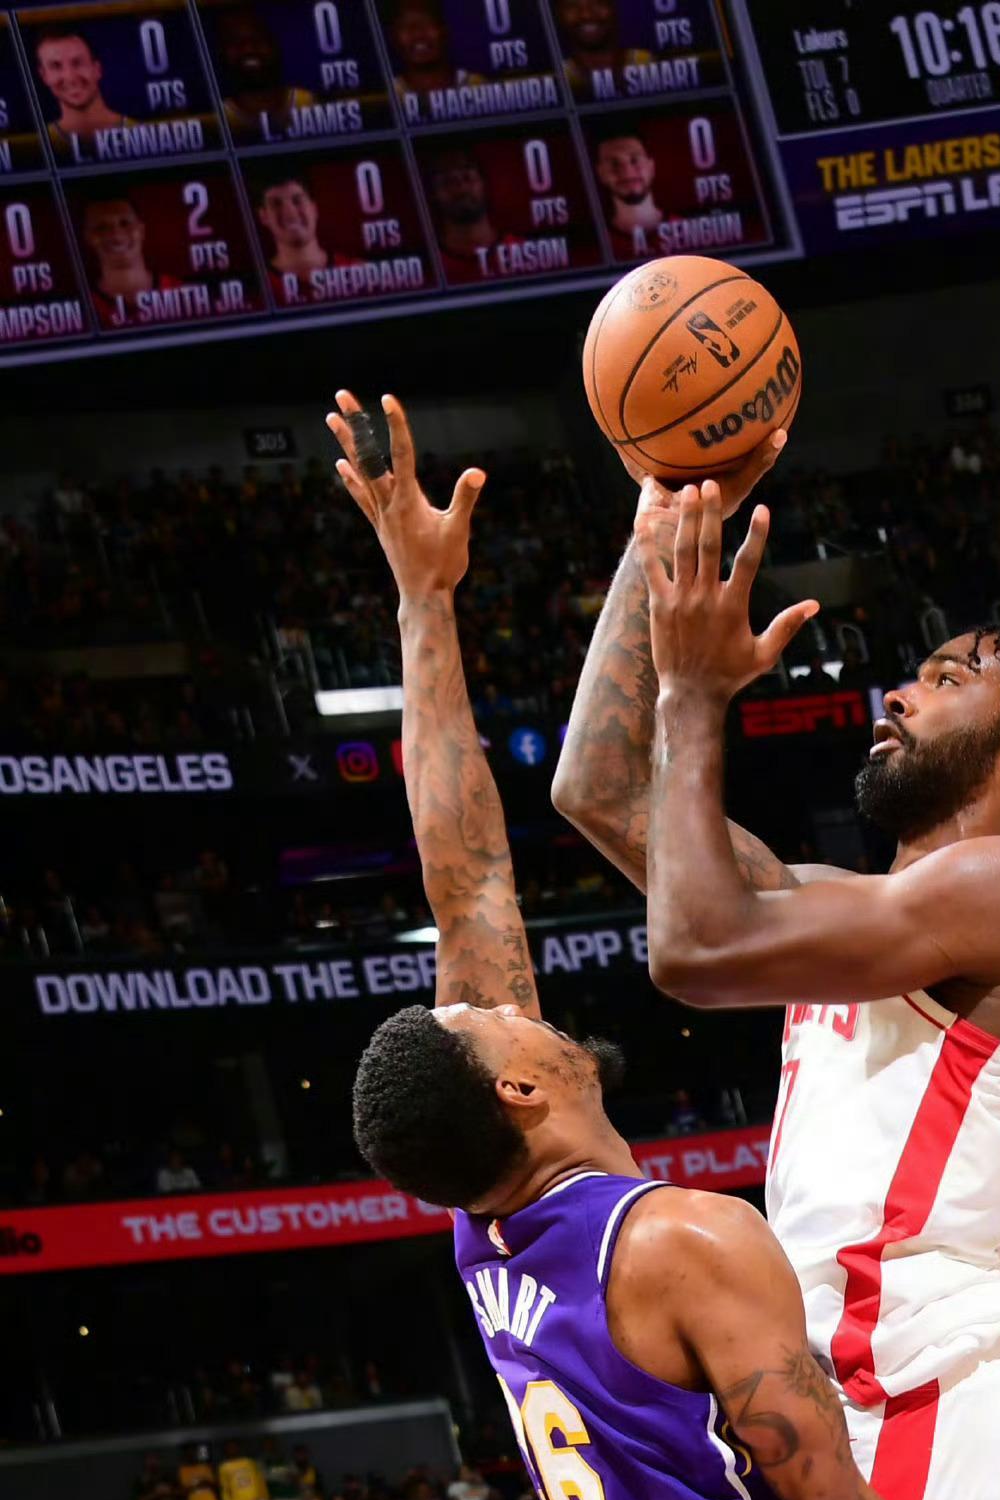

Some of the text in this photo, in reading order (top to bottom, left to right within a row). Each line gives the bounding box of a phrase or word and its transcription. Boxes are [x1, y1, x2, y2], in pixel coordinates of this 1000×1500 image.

[140, 20, 169, 74] 0
[314, 1, 342, 54] 0
[655, 18, 693, 47] PTS
[321, 60, 359, 89] PTS
[489, 40, 528, 68] PTS
[147, 80, 186, 110] PTS
[430, 75, 558, 117] HACHIMURA
[623, 57, 700, 95] SMART
[95, 119, 204, 159] KENNARD
[287, 100, 362, 138] JAMES
[688, 117, 716, 169] 0
[816, 151, 878, 192] THE
[884, 133, 1000, 182] LAKERS
[524, 139, 552, 192] 0
[356, 160, 384, 214] 0
[695, 173, 733, 203] PTS
[834, 182, 957, 231] ESPN
[182, 182, 212, 236] 2
[530, 196, 569, 226] PTS
[6, 203, 34, 257] 0
[362, 218, 401, 248] PTS
[190, 241, 229, 271] PTS
[498, 236, 568, 275] EASON
[13, 263, 52, 293] PTS
[310, 256, 424, 299] SHEPPARD
[136, 285, 209, 322] SMITH
[690, 345, 800, 449] Wilson
[741, 690, 866, 737] ESPN
[0, 755, 233, 793] OSANGELES
[36, 967, 271, 1013] DOWNLOAD
[274, 961, 359, 1001] THE
[543, 930, 622, 973] APP
[122, 1215, 201, 1244] THE
[209, 1194, 408, 1237] CUSTOMER
